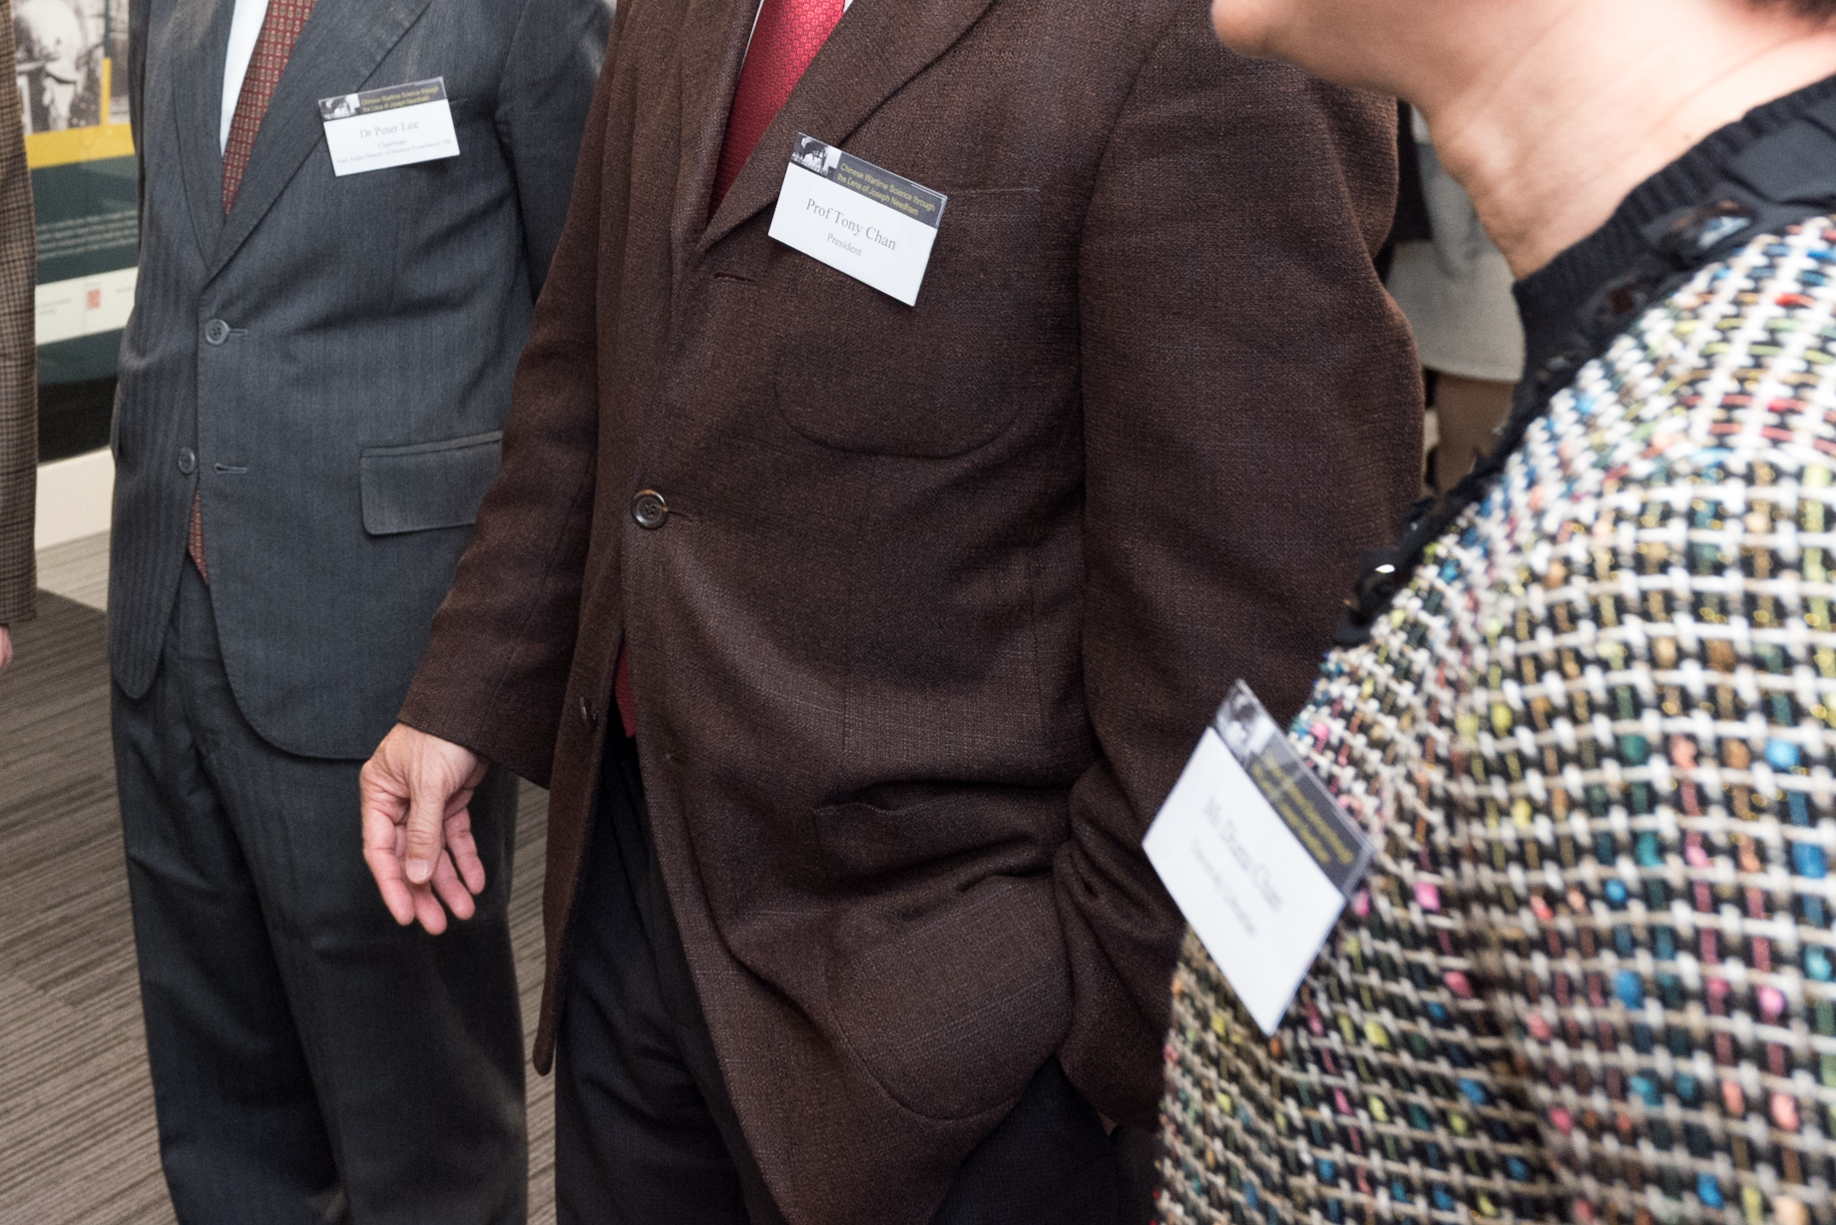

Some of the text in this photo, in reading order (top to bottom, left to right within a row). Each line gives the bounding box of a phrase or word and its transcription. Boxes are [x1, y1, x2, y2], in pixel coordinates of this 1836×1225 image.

[359, 121, 418, 139] Dr Peter Lee
[837, 174, 918, 216] the Lens of Joseph Needham
[840, 163, 935, 212] Chinese Wartime Science through
[806, 198, 896, 250] Prof Tony Chan
[827, 233, 862, 256] President
